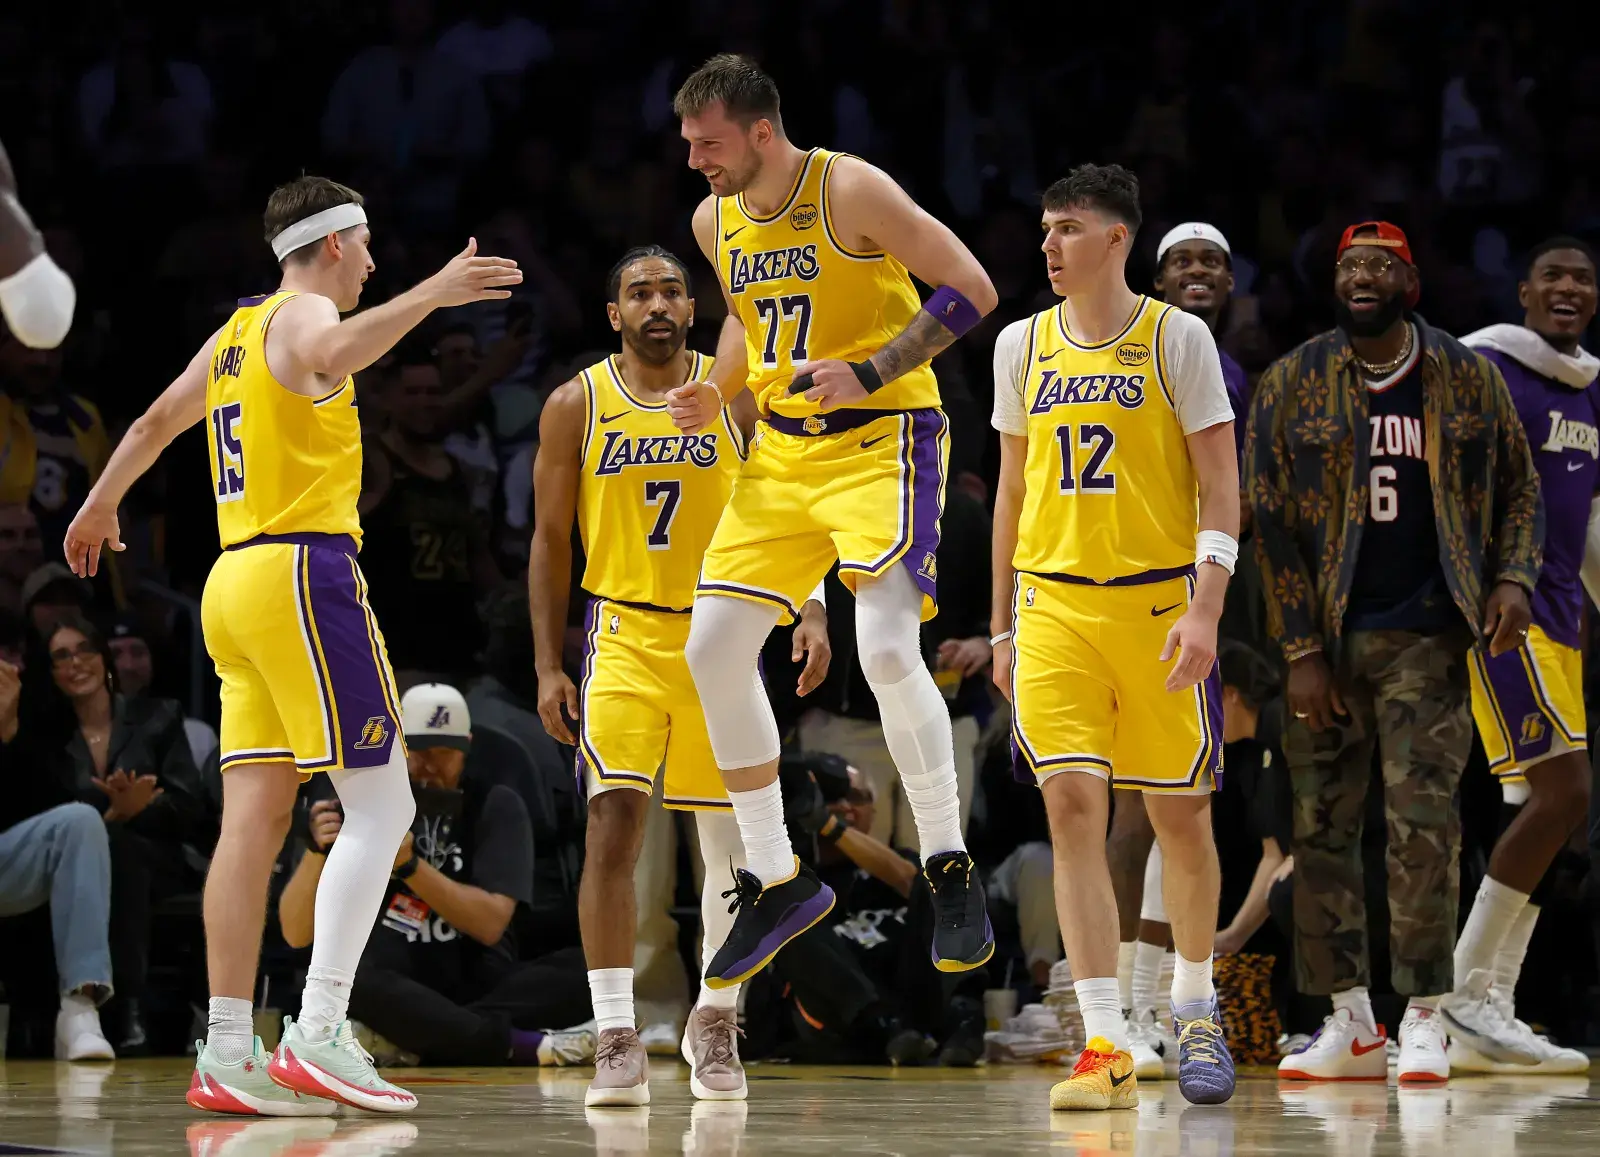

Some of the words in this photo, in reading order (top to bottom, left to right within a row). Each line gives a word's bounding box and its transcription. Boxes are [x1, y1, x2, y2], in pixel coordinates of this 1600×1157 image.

[792, 210, 817, 222] bibigo
[729, 244, 820, 294] LAKERS
[753, 294, 813, 369] 77
[1119, 348, 1149, 361] bibigo
[214, 345, 246, 384] REAES
[1029, 368, 1147, 416] LAKERS
[212, 400, 245, 504] 15
[594, 430, 719, 477] LAKERS
[1055, 422, 1117, 495] 12
[1541, 410, 1599, 460] LAKERS
[644, 479, 682, 551] 7
[1369, 465, 1398, 522] 6
